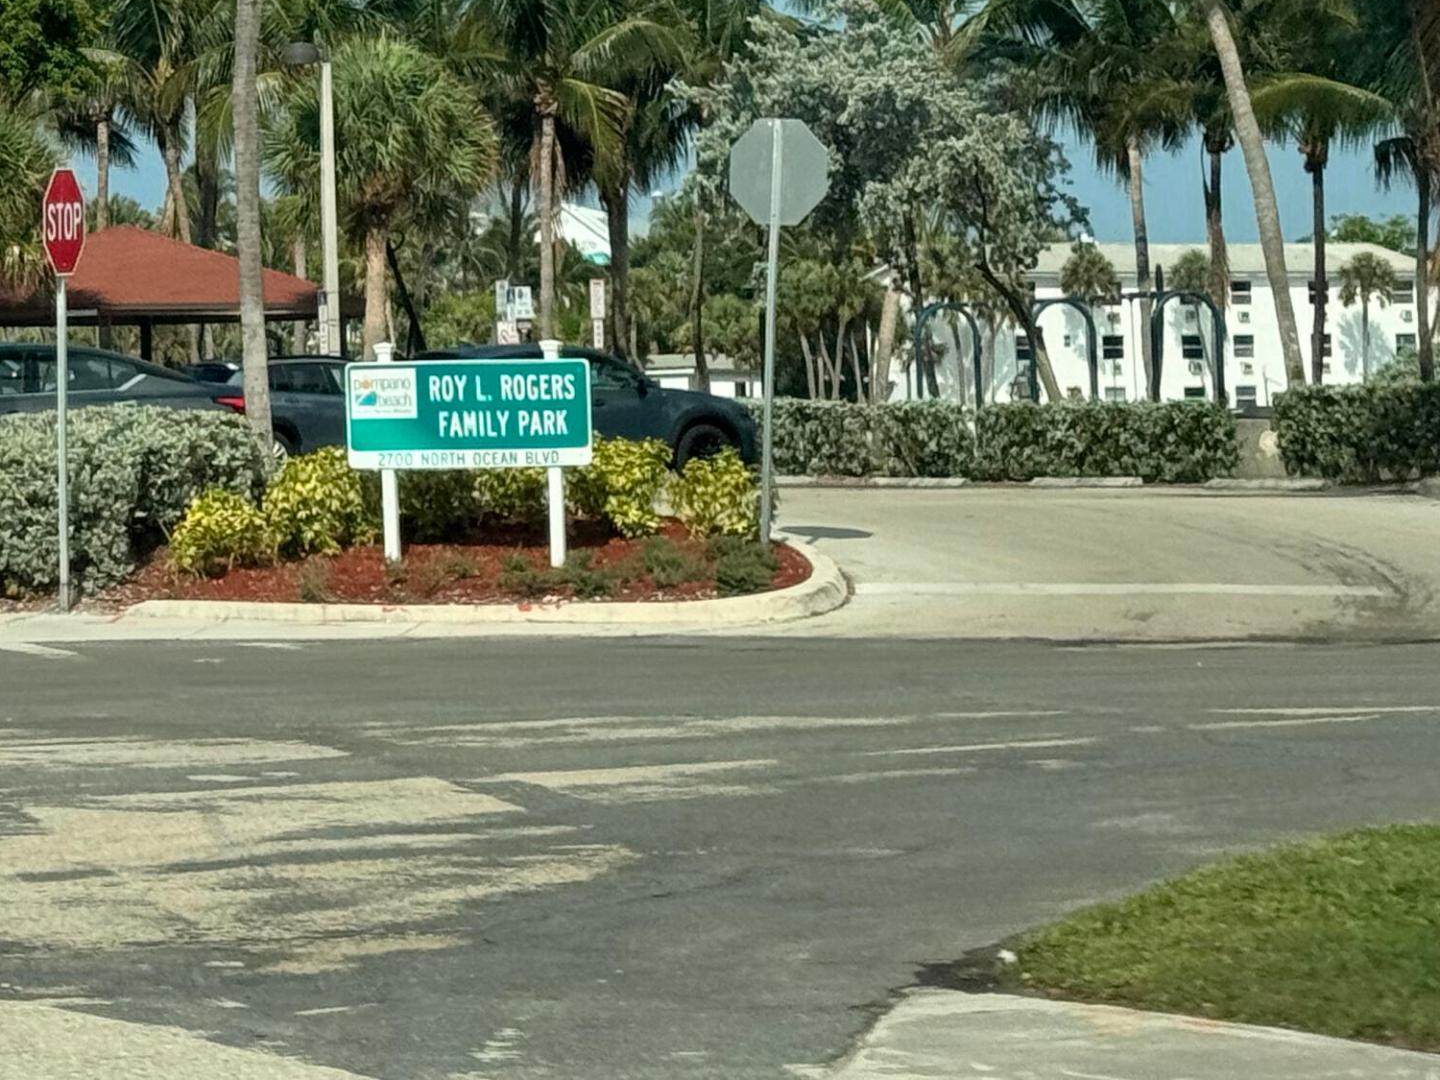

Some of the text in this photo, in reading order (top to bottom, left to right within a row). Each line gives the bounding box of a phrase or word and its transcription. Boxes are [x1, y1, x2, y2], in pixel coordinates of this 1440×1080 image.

[47, 202, 82, 241] STOP
[429, 374, 576, 402] ROY L. ROGERS
[438, 409, 569, 437] FAMILY PARK
[377, 450, 560, 467] 2700 NORTH OCEAN BLVD
